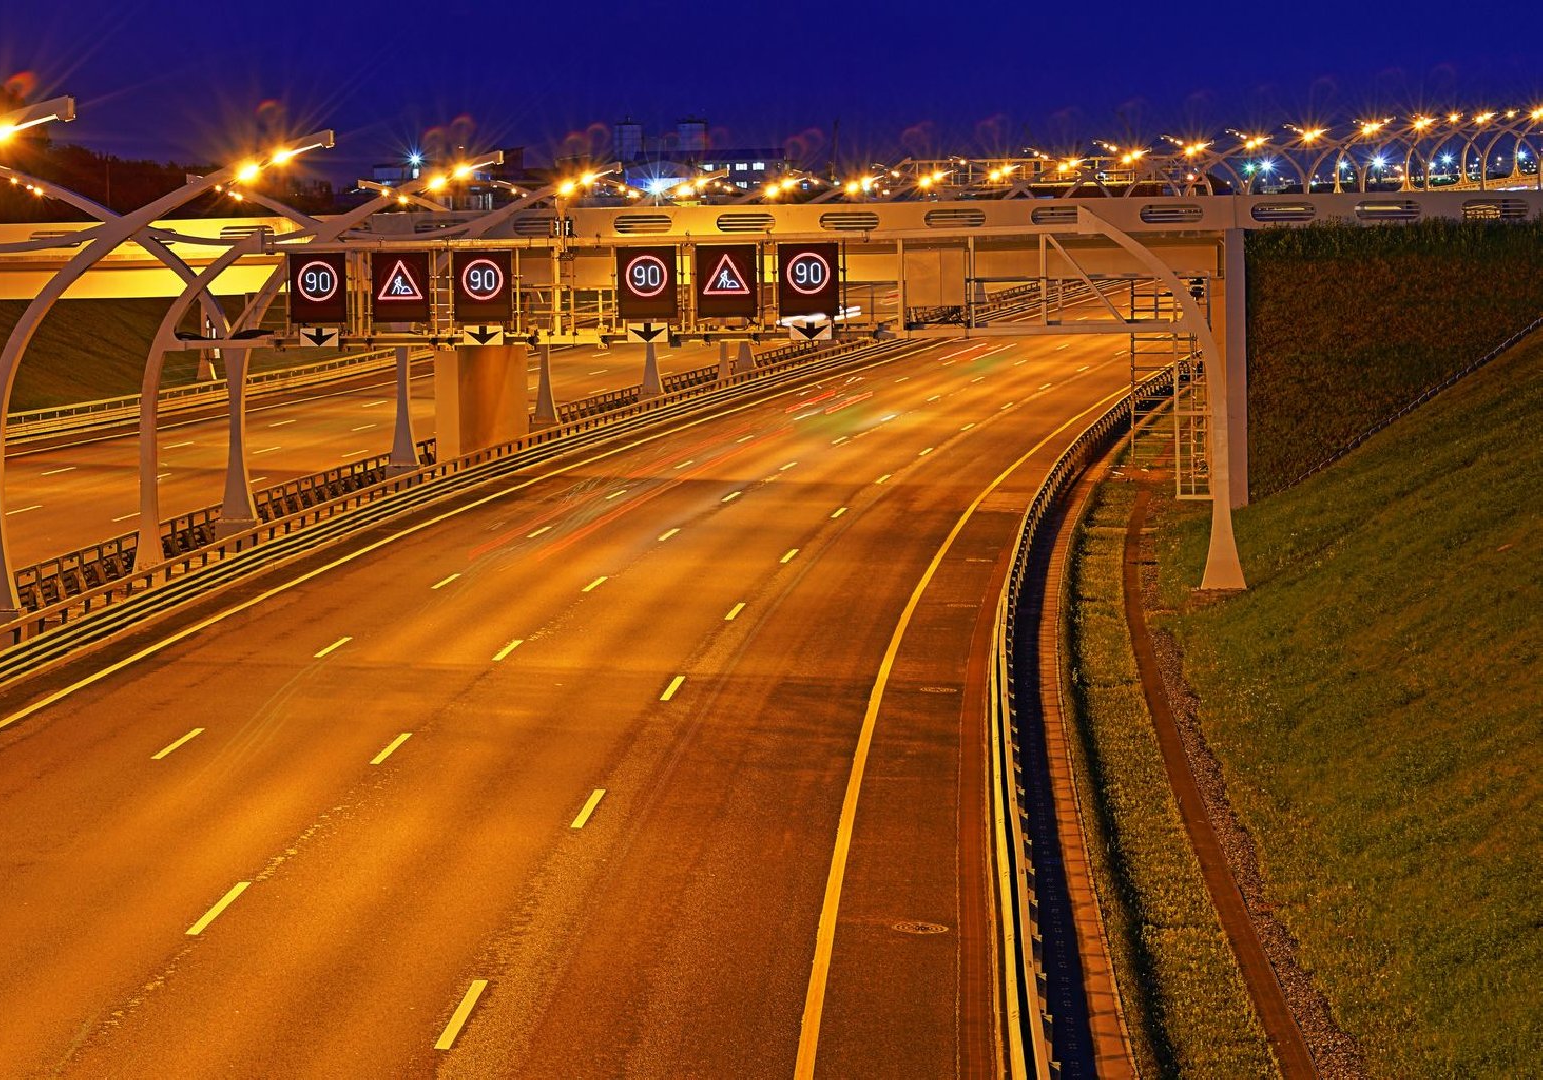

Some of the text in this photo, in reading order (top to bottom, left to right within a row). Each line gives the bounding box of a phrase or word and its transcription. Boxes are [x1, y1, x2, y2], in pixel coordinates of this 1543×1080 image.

[305, 271, 330, 292] 90
[470, 269, 495, 291] 90
[633, 265, 660, 286] 90
[795, 262, 822, 284] 90
